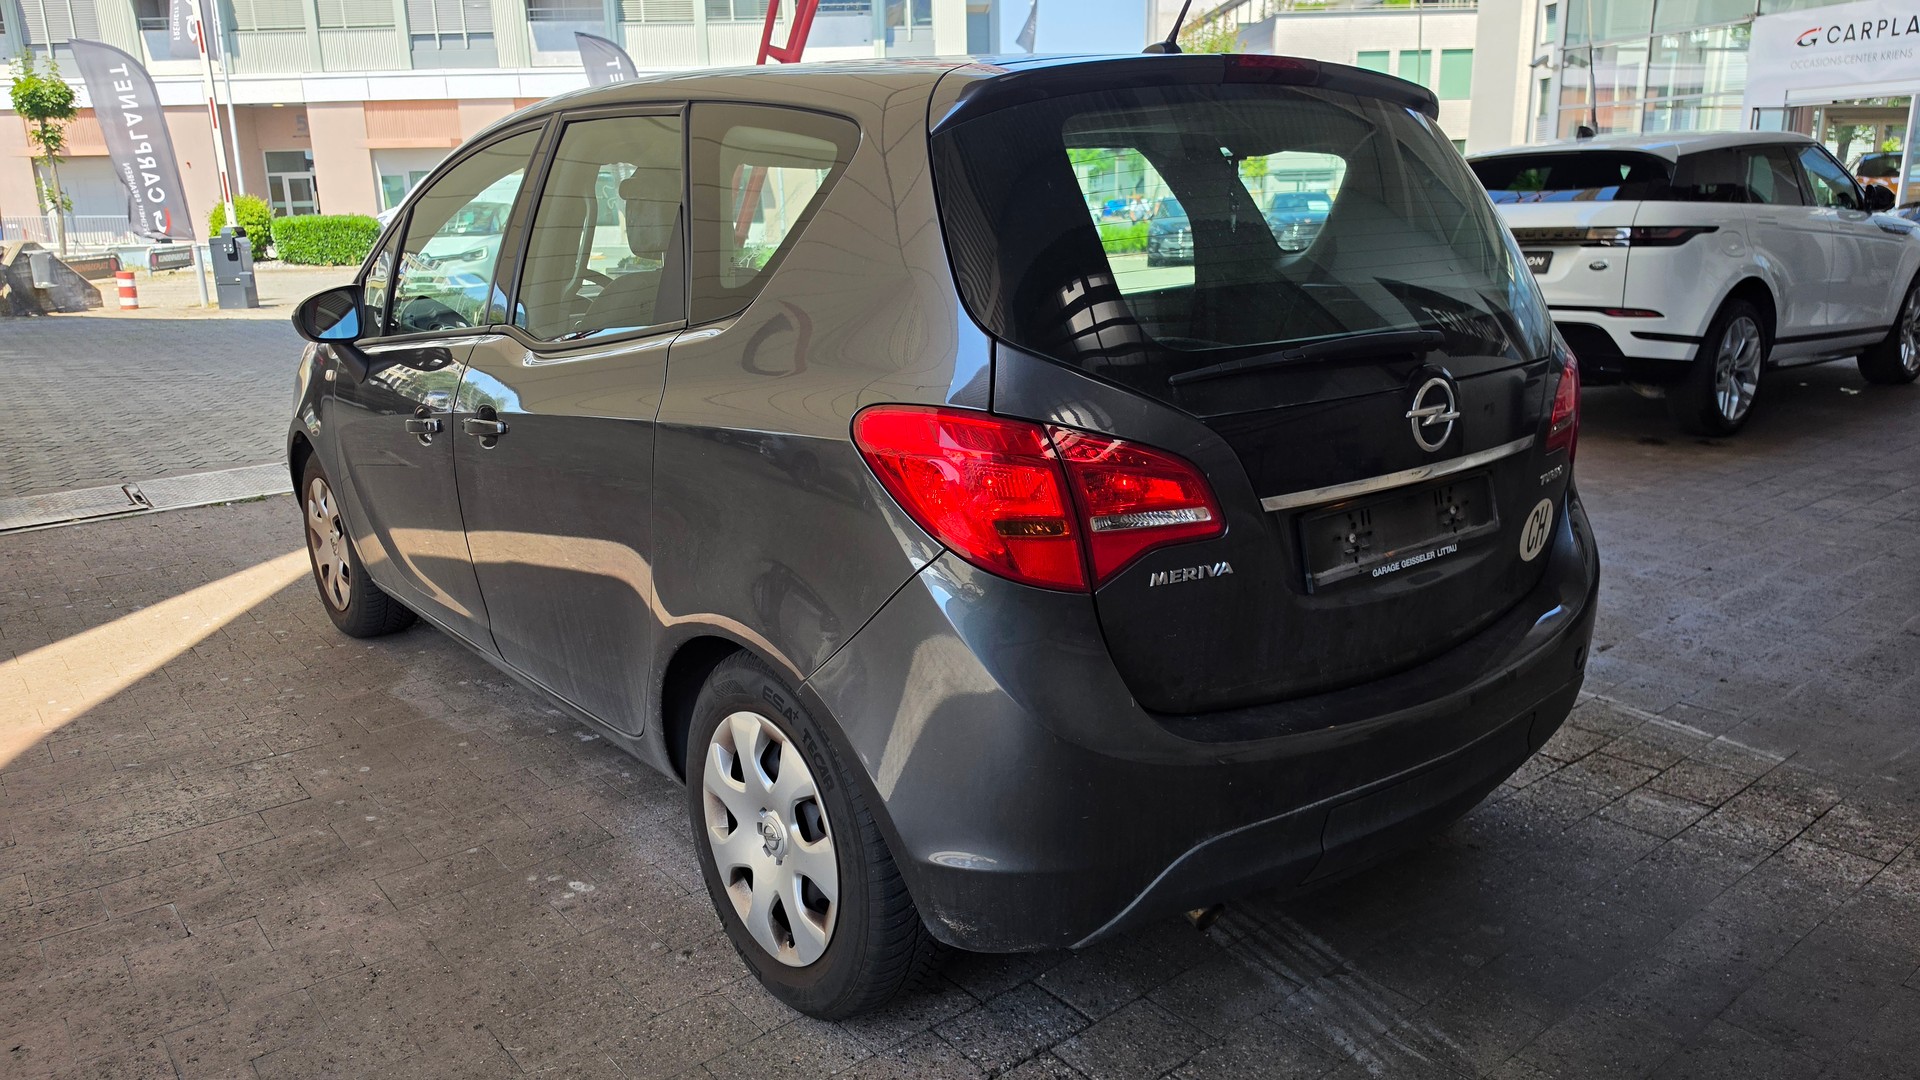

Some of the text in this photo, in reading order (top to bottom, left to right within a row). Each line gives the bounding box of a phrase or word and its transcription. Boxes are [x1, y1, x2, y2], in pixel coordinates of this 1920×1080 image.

[1827, 15, 1920, 44] CARPLA
[1881, 48, 1913, 61] KRIENS
[1526, 503, 1550, 553] CH
[1149, 561, 1234, 587] MERIVA
[1372, 543, 1458, 578] GARAGE GEISSELER LITTAU
